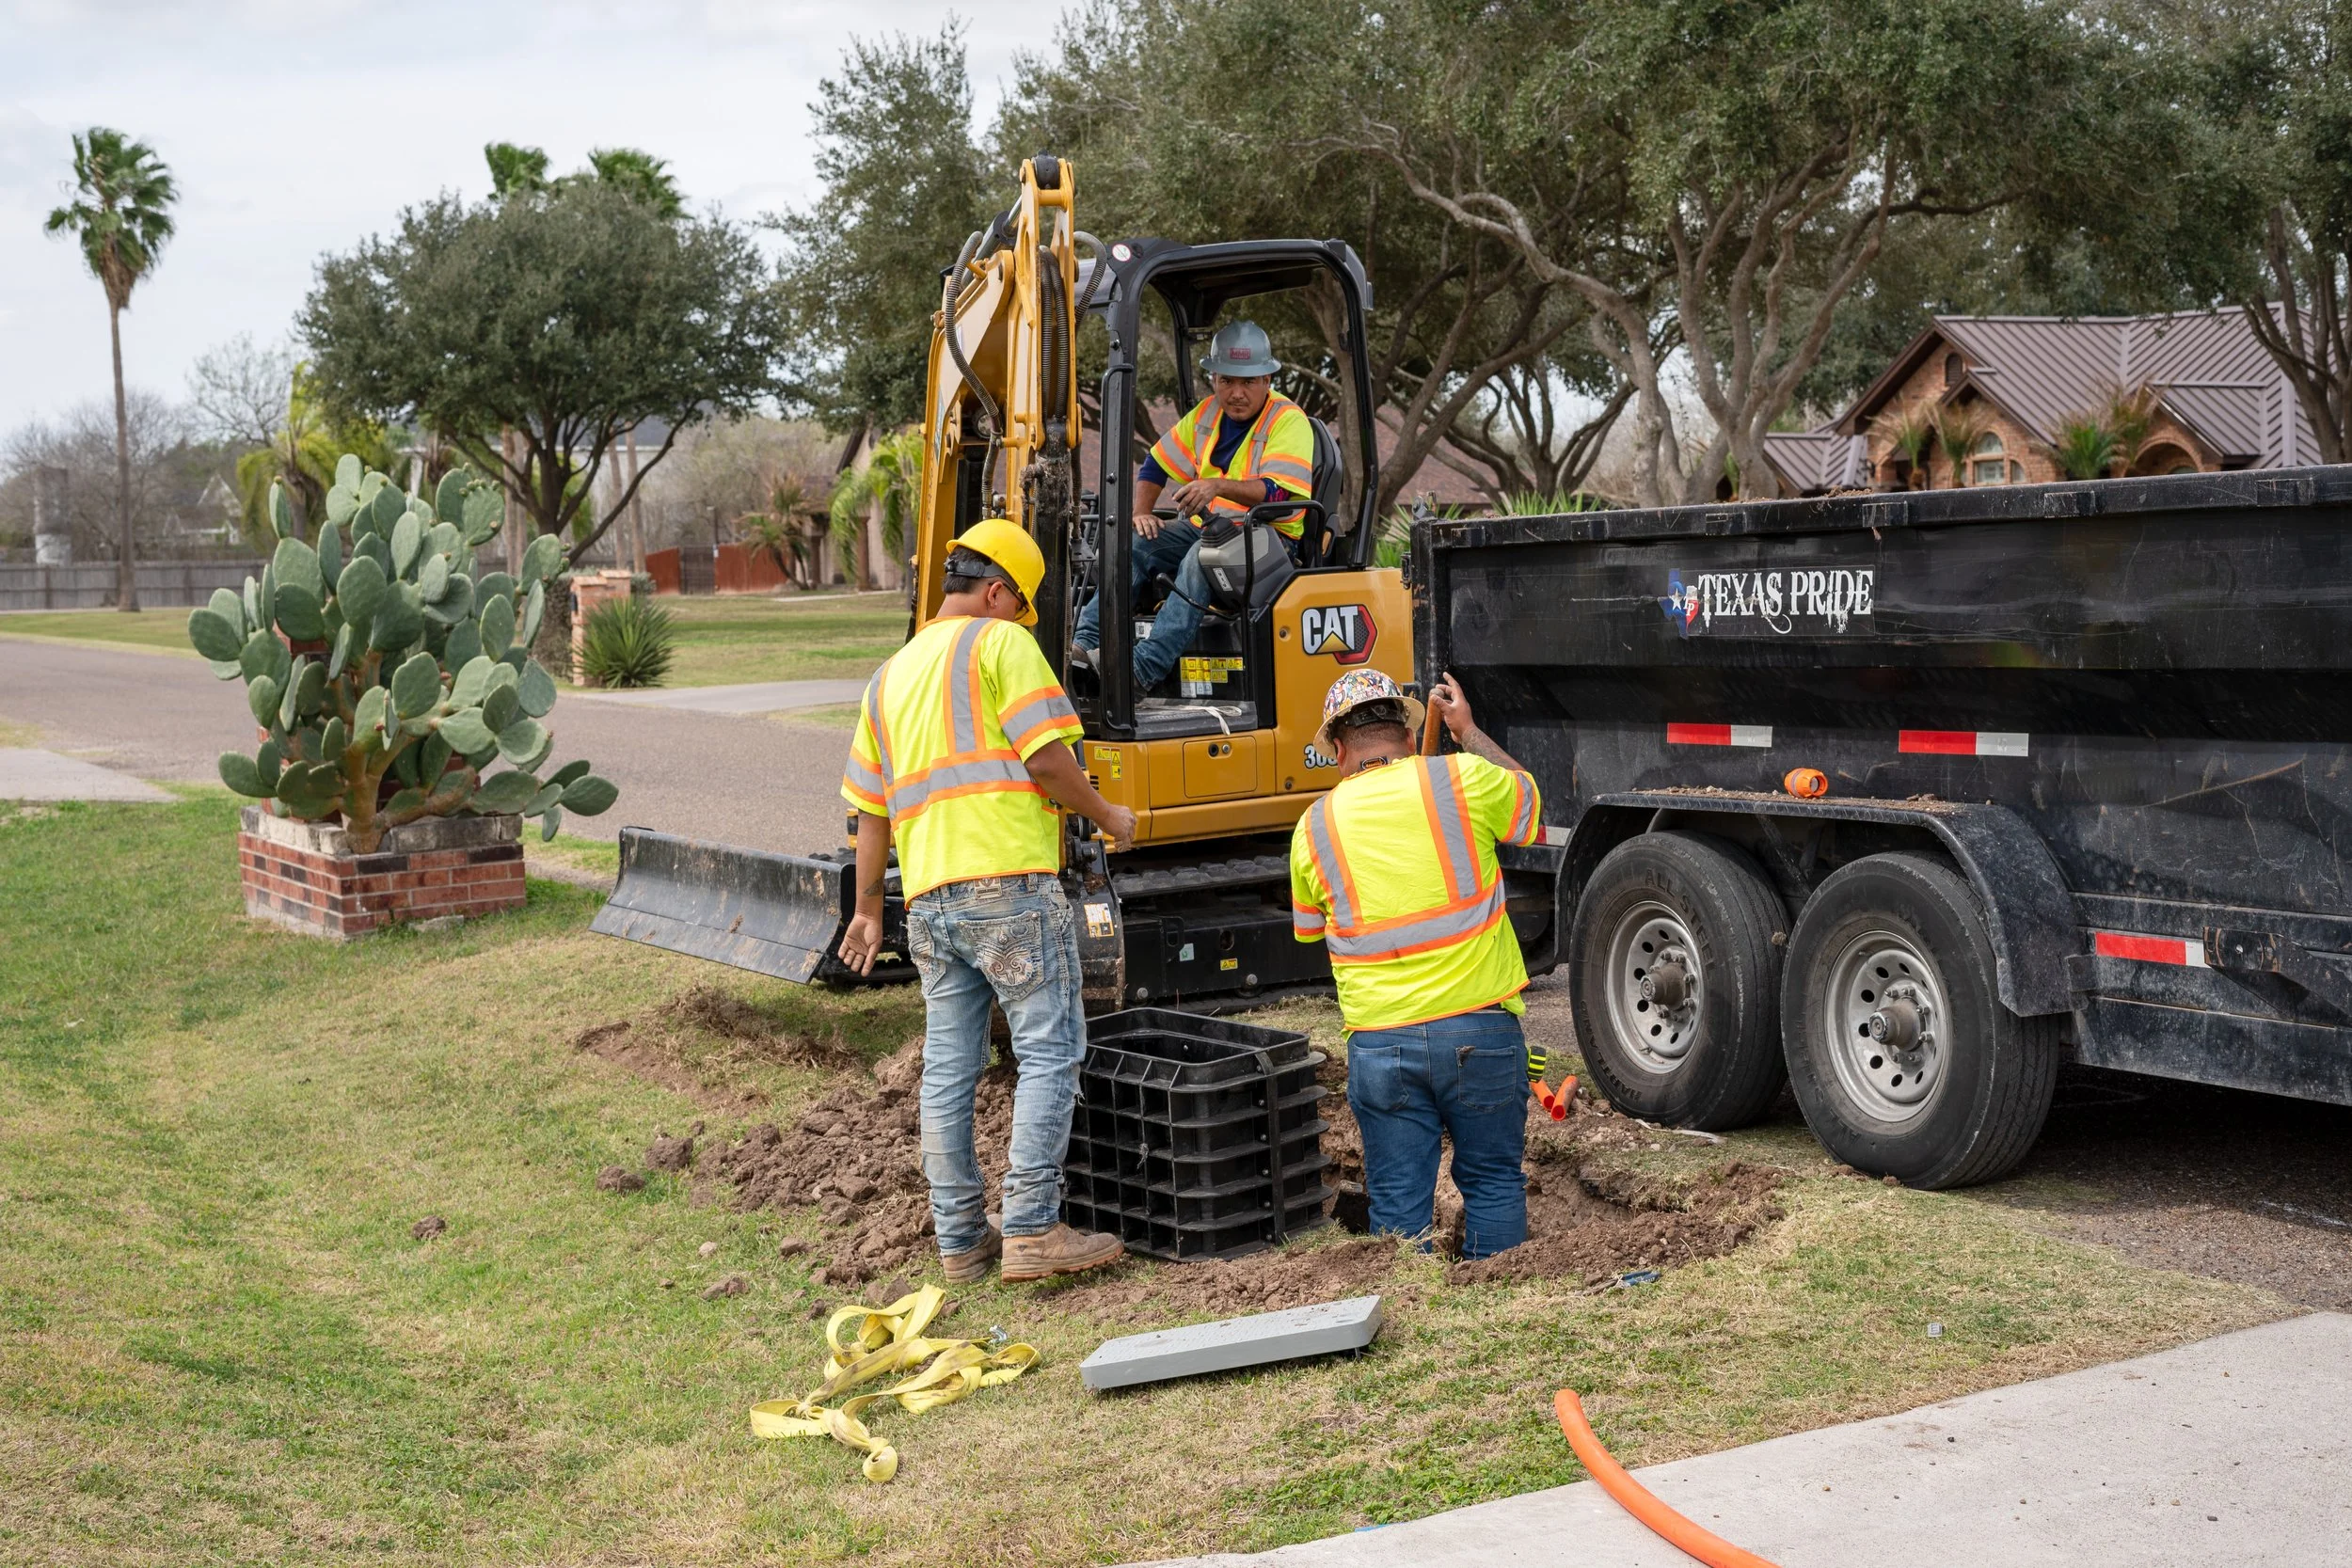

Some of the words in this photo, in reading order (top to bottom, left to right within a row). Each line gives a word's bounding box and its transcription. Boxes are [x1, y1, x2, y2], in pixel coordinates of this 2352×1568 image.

[1683, 596, 1695, 616] TP
[1698, 572, 1789, 628] TEXAS
[1789, 570, 1873, 625] PRIDE
[1302, 606, 1358, 655] CAT
[1645, 868, 1676, 897] ALL
[1680, 895, 1716, 976] STEEL
